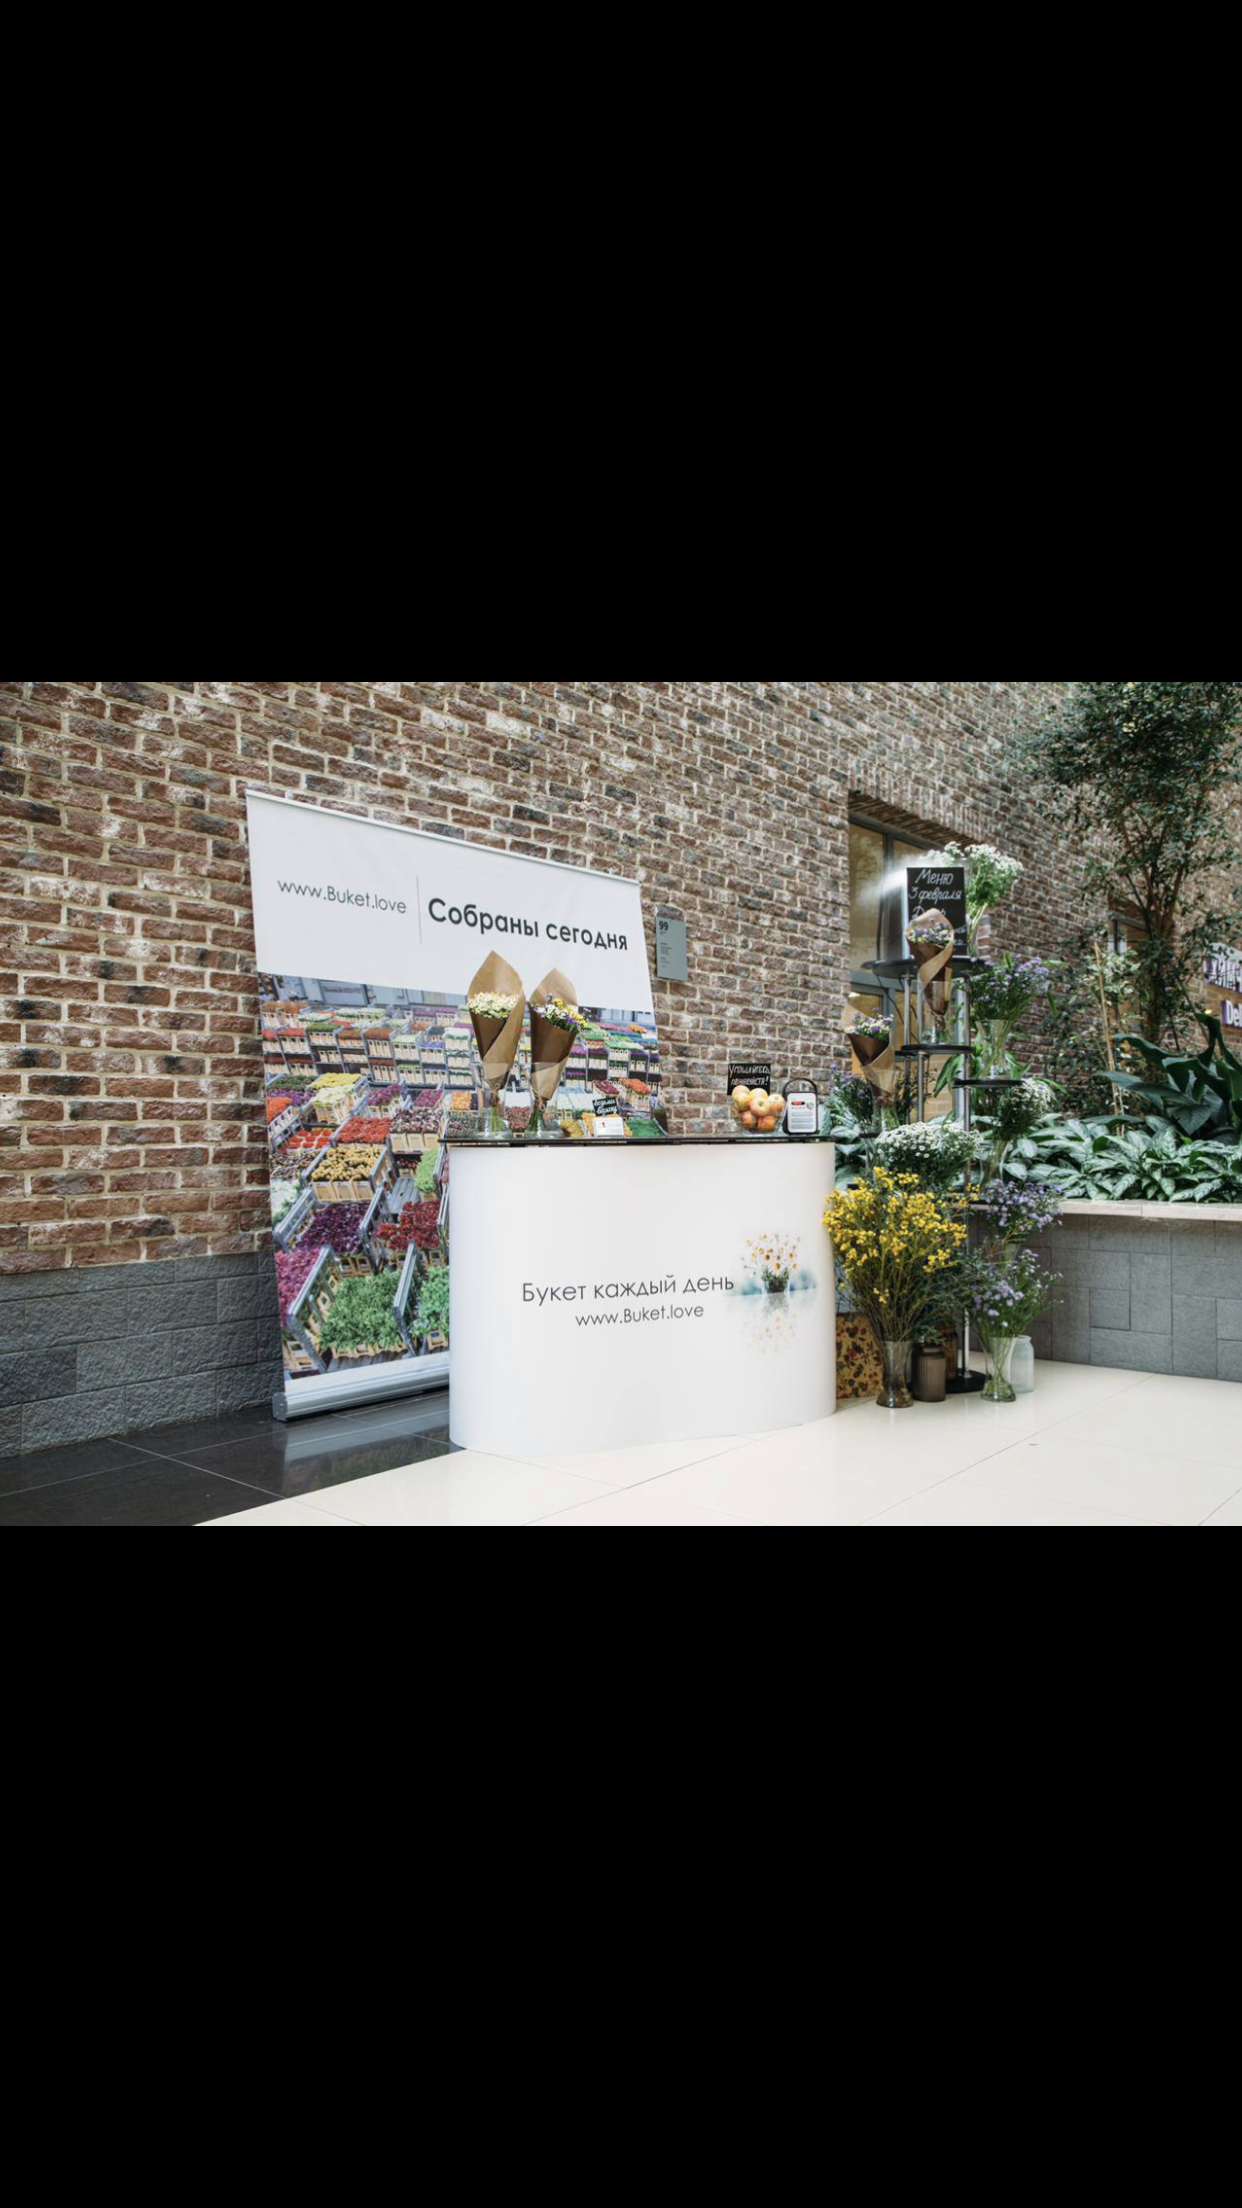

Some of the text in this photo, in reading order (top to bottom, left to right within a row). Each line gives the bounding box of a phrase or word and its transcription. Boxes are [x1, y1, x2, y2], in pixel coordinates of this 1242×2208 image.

[915, 869, 954, 885] Меню
[277, 879, 407, 914] www.Buket.love
[908, 886, 962, 905] 3 февраля
[428, 897, 628, 951] Собраны сегодня
[658, 920, 669, 931] 99
[522, 1274, 735, 1306] Букет каждый день
[575, 1303, 705, 1327] www.Buket.love
